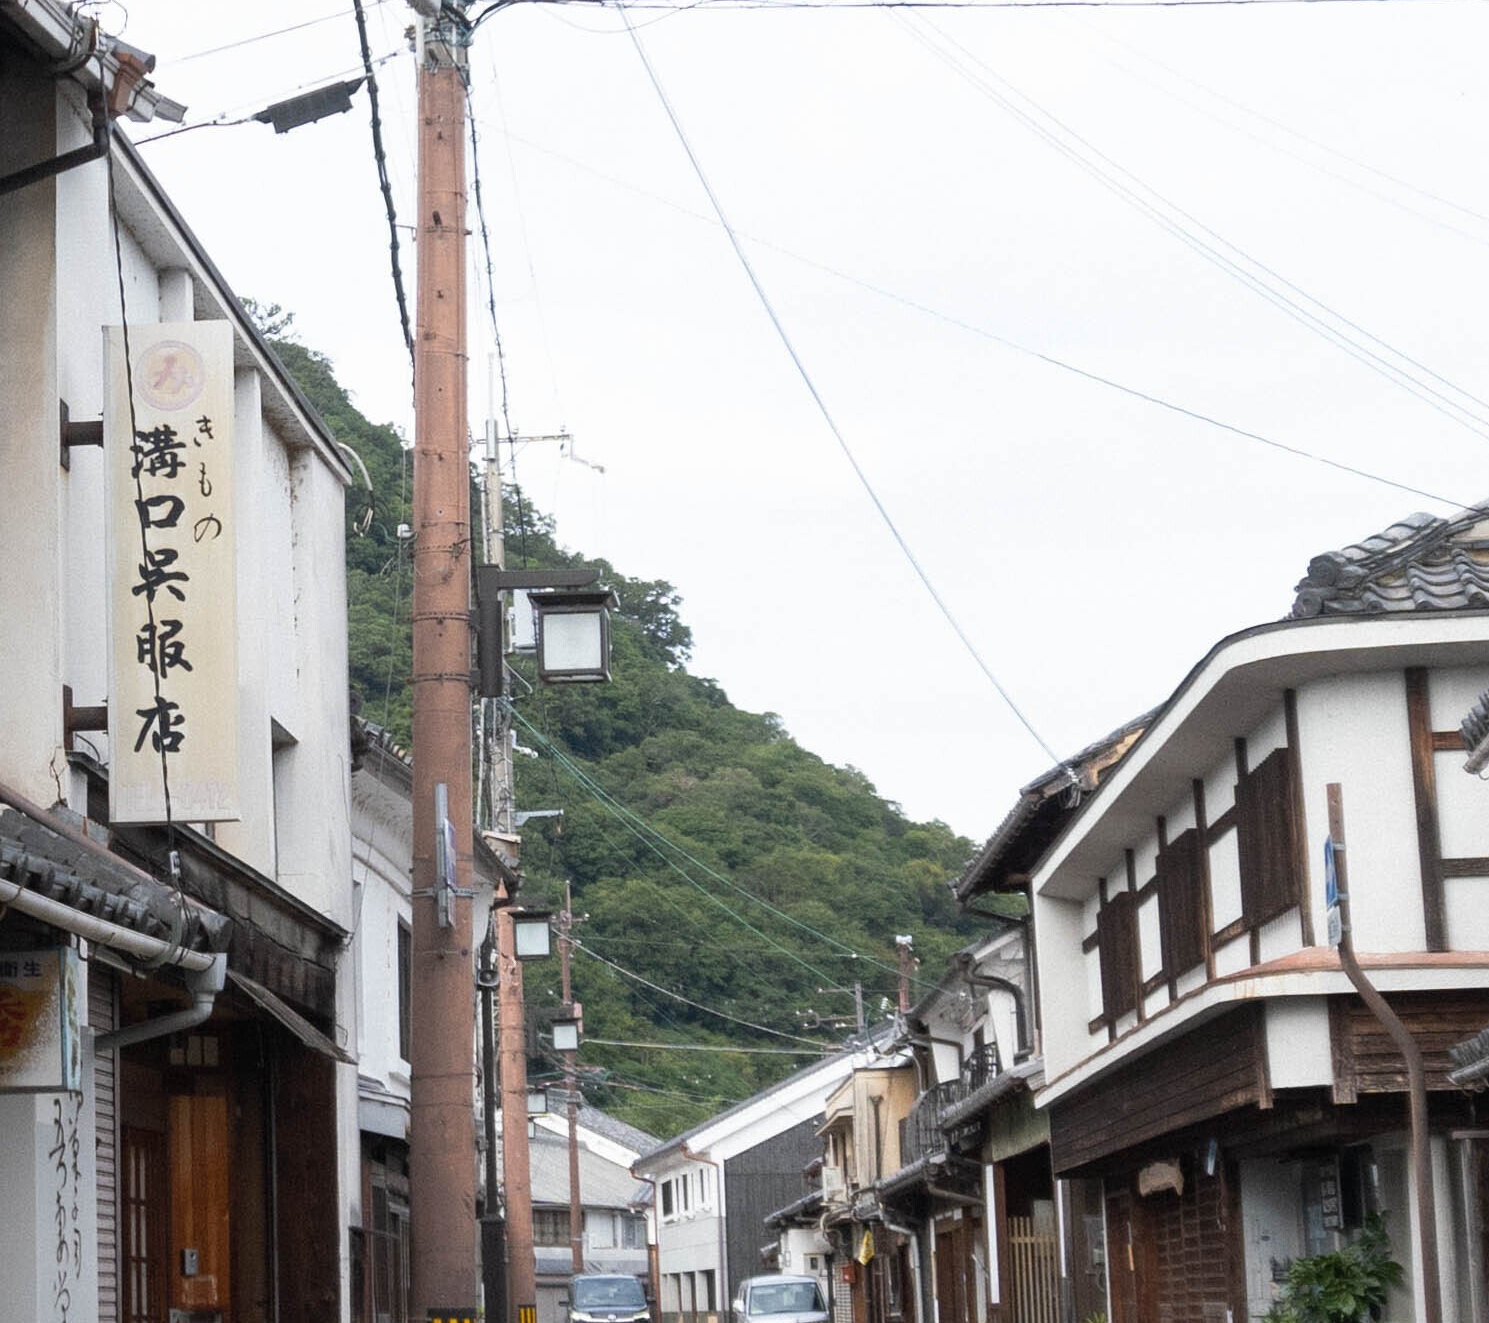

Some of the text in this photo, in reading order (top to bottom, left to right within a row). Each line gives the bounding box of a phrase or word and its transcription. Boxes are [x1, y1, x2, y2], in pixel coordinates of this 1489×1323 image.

[129, 425, 193, 755] 溝口呉服店
[193, 412, 223, 544] きもの
